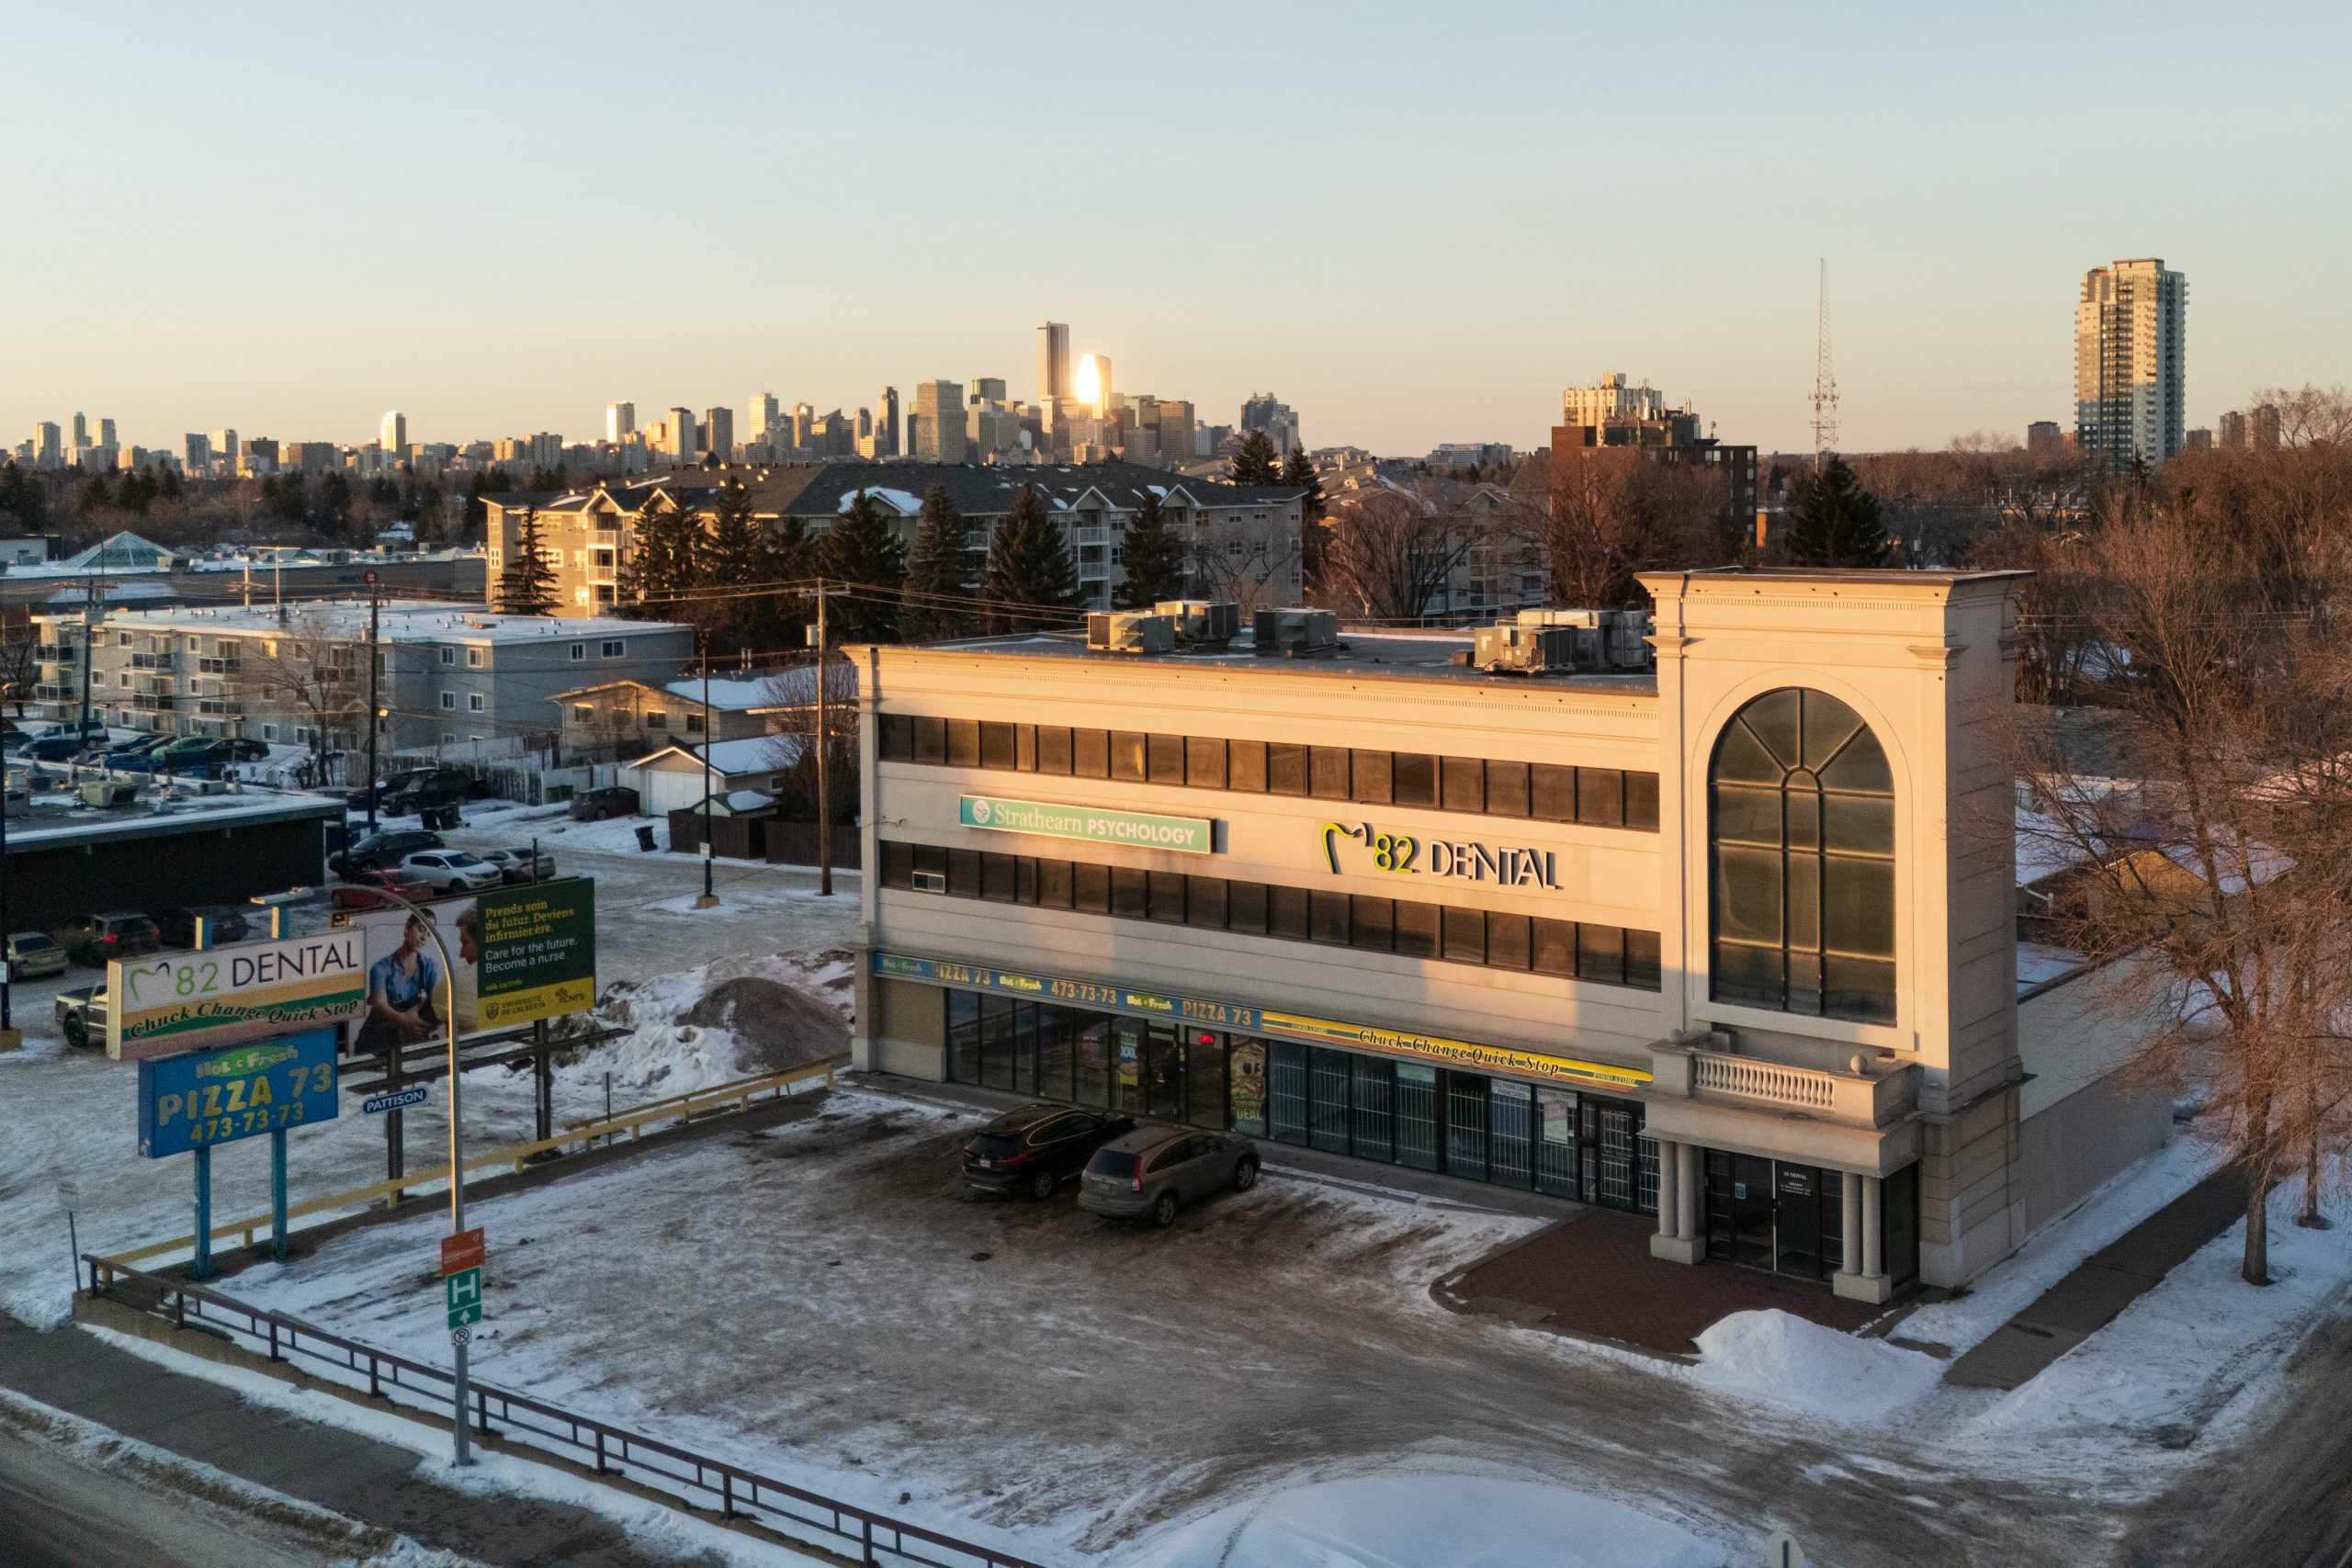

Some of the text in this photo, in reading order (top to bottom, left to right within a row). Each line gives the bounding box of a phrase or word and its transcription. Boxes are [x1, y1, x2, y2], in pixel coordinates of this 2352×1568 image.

[994, 804, 1195, 845] Strathearn PSYCHOLOGY
[1374, 834, 1556, 890] 82 DENTAL
[485, 899, 548, 918] Prends soin
[485, 919, 499, 931] du
[534, 908, 574, 922] Deviens
[485, 937, 577, 961] Care for the future.
[485, 958, 527, 974] Become
[529, 957, 536, 965] a
[175, 941, 358, 996] 82 DENTAL
[932, 962, 969, 983] PIZZA
[974, 969, 990, 986] 73
[1051, 980, 1116, 1005] 473-73-73
[1182, 999, 1227, 1022] PIZZA
[1232, 1008, 1251, 1027] 73
[130, 999, 358, 1039] Chuck Change Quick Stop
[196, 1061, 231, 1079] Hot
[246, 1045, 299, 1067] Fresh
[1359, 1029, 1404, 1048] Chuck
[1412, 1037, 1468, 1060] Change
[1471, 1047, 1516, 1066] Quick
[1524, 1055, 1560, 1076] Stop
[1593, 1071, 1613, 1080] FOOD
[1614, 1075, 1637, 1085] STORE
[159, 1063, 332, 1126] PIZZA 73
[368, 1091, 423, 1112] PATTISON
[190, 1100, 304, 1142] 473-73-73
[1236, 1108, 1261, 1121] DEAL
[452, 1273, 476, 1304] H
